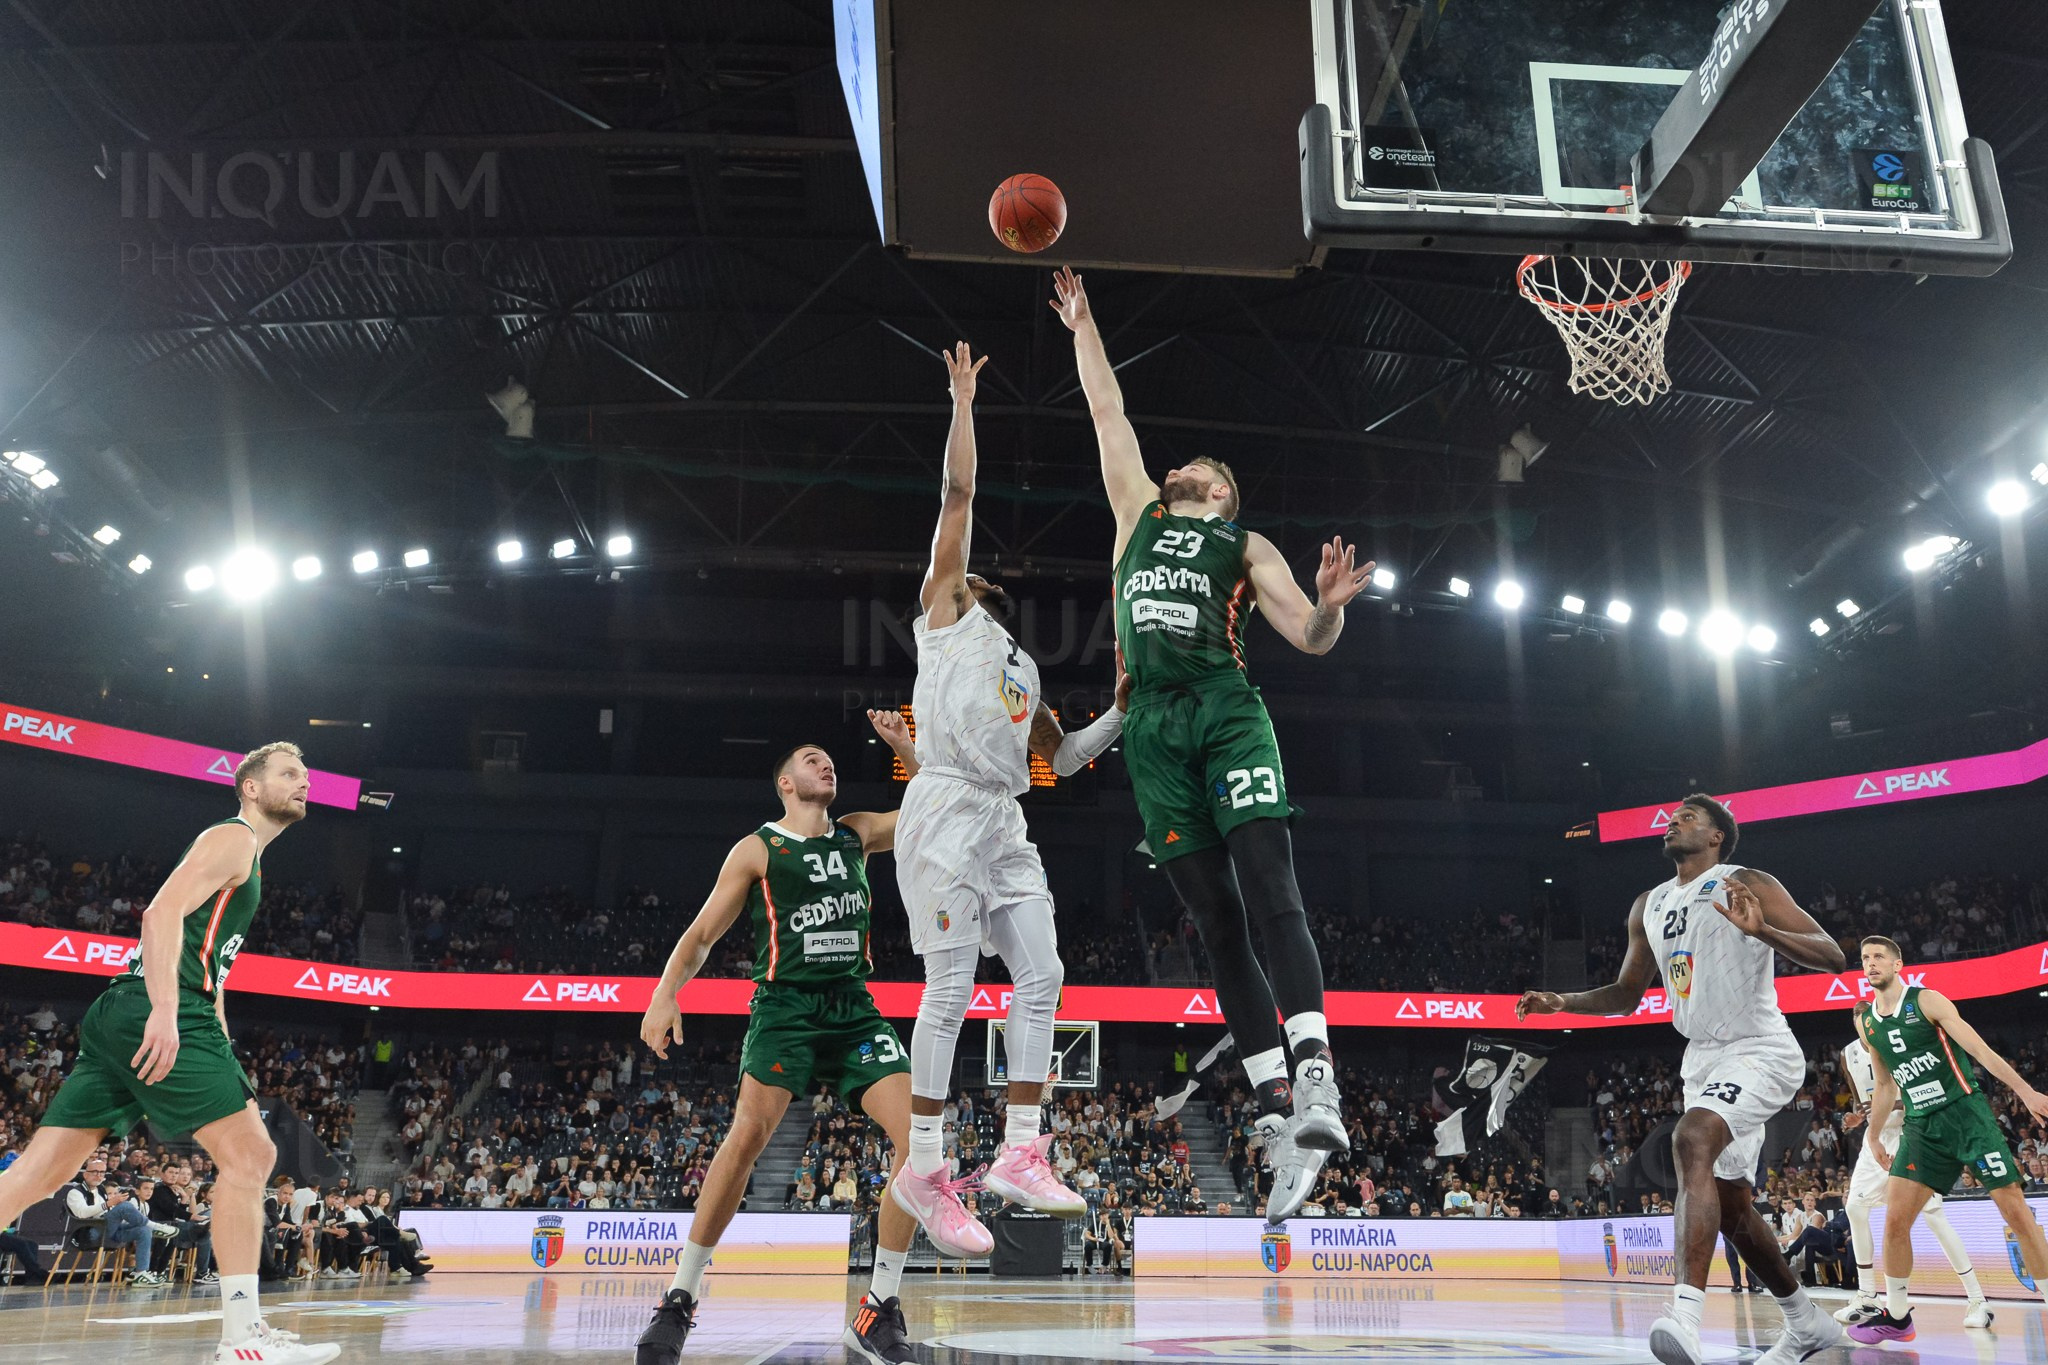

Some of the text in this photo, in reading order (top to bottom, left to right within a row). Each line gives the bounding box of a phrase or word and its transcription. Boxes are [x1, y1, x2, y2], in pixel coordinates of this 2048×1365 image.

[1387, 153, 1435, 162] oneteam
[1874, 186, 1911, 196] BKT
[1872, 198, 1918, 210] EuroCup
[1152, 530, 1205, 559] 23
[1123, 565, 1212, 600] CEDEVITA
[1139, 604, 1190, 620] PETROL
[3, 711, 76, 744] PEAK
[1226, 767, 1278, 809] 23
[1885, 768, 1951, 794] PEAK
[803, 850, 848, 882] 34
[790, 890, 865, 933] CEDEVITA
[1663, 906, 1688, 940] 23
[84, 941, 135, 967] PEA
[811, 937, 856, 947] PETROL
[327, 971, 392, 997] PEAK
[556, 982, 620, 1003] PEAK
[1425, 1000, 1485, 1020] PEAK
[1635, 995, 1673, 1015] PEA
[1887, 1029, 1907, 1053] 5
[1700, 1081, 1742, 1105] 23
[1984, 1151, 2008, 1177] 5
[586, 1217, 678, 1240] PRIMĂRIA
[1311, 1224, 1397, 1247] PRIMĂRIA
[1623, 1223, 1663, 1247] PRIMĂRIA
[584, 1246, 712, 1266] CLUJ-NAPO
[1312, 1253, 1434, 1272] CLUJ-NAPOCA
[1626, 1255, 1676, 1276] CLUJ-NAPOC
